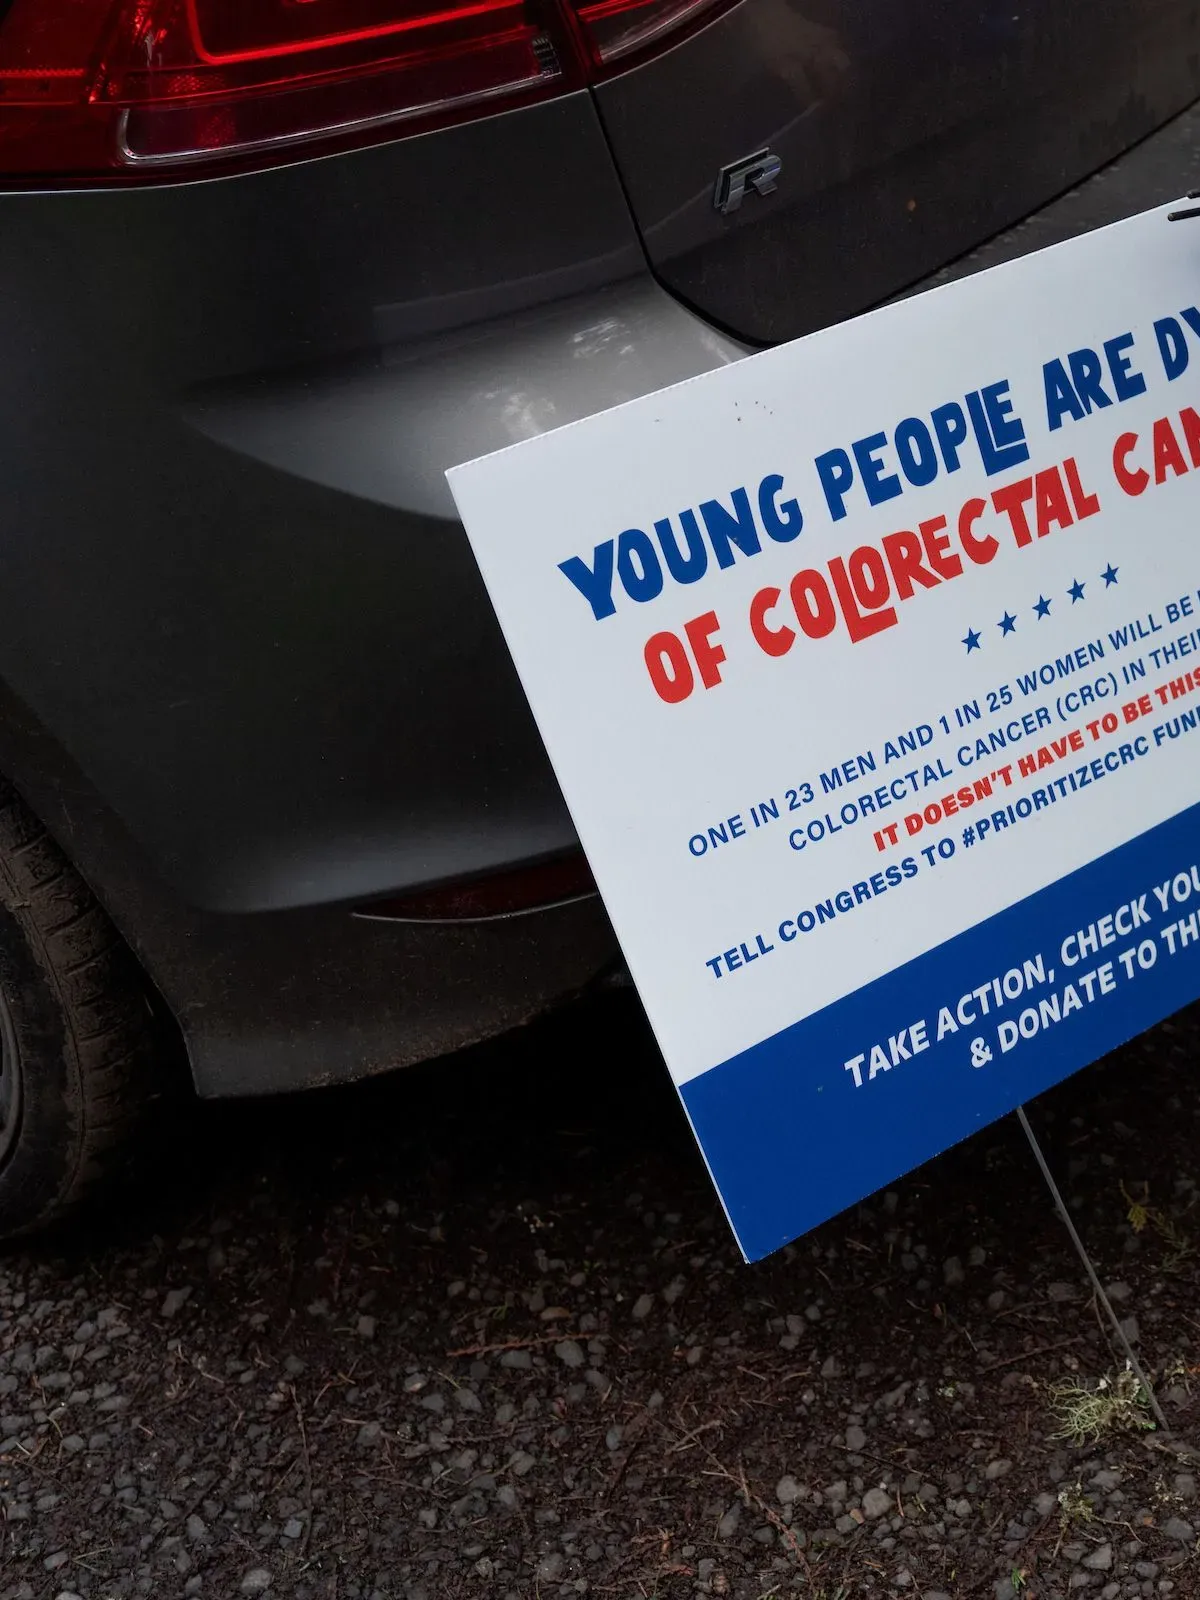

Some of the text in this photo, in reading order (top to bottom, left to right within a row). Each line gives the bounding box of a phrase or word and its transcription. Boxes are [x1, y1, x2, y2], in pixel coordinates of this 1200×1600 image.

[557, 474, 803, 621] YOUNG
[814, 379, 1030, 522] PEOPLE
[1043, 332, 1147, 432] ARE
[644, 610, 726, 704] OF
[750, 457, 1100, 657] COLORECTAL
[689, 814, 746, 856] ONE
[750, 798, 779, 827] IN
[785, 783, 814, 811] 23
[819, 751, 876, 793] MEN
[885, 725, 933, 764] AND
[939, 716, 950, 734] 1
[955, 700, 981, 727] IN
[986, 685, 1012, 712] 25
[1016, 640, 1105, 696] WOMEN
[1108, 614, 1162, 651] WILL
[1166, 596, 1193, 624] BE
[789, 759, 953, 850] COLORECTAL
[958, 707, 1051, 766] CANCER
[1057, 672, 1118, 721] (CRC)
[1122, 658, 1146, 685] IN
[873, 823, 898, 852] IT
[904, 765, 1012, 836] DOESN'T
[1018, 729, 1084, 778] HAVE
[1086, 713, 1118, 741] TO
[1122, 694, 1153, 724] BE
[706, 935, 774, 979] TELL
[779, 857, 918, 942] CONGRESS
[921, 838, 955, 867] TO
[962, 736, 1149, 848] #PRIORITIZECRC
[844, 1020, 929, 1087] TAKE
[937, 954, 1054, 1041] ACTION,
[1061, 894, 1151, 966] CHECK
[971, 1037, 992, 1067] &
[998, 962, 1116, 1053] DONATE
[1119, 940, 1156, 978] TO
